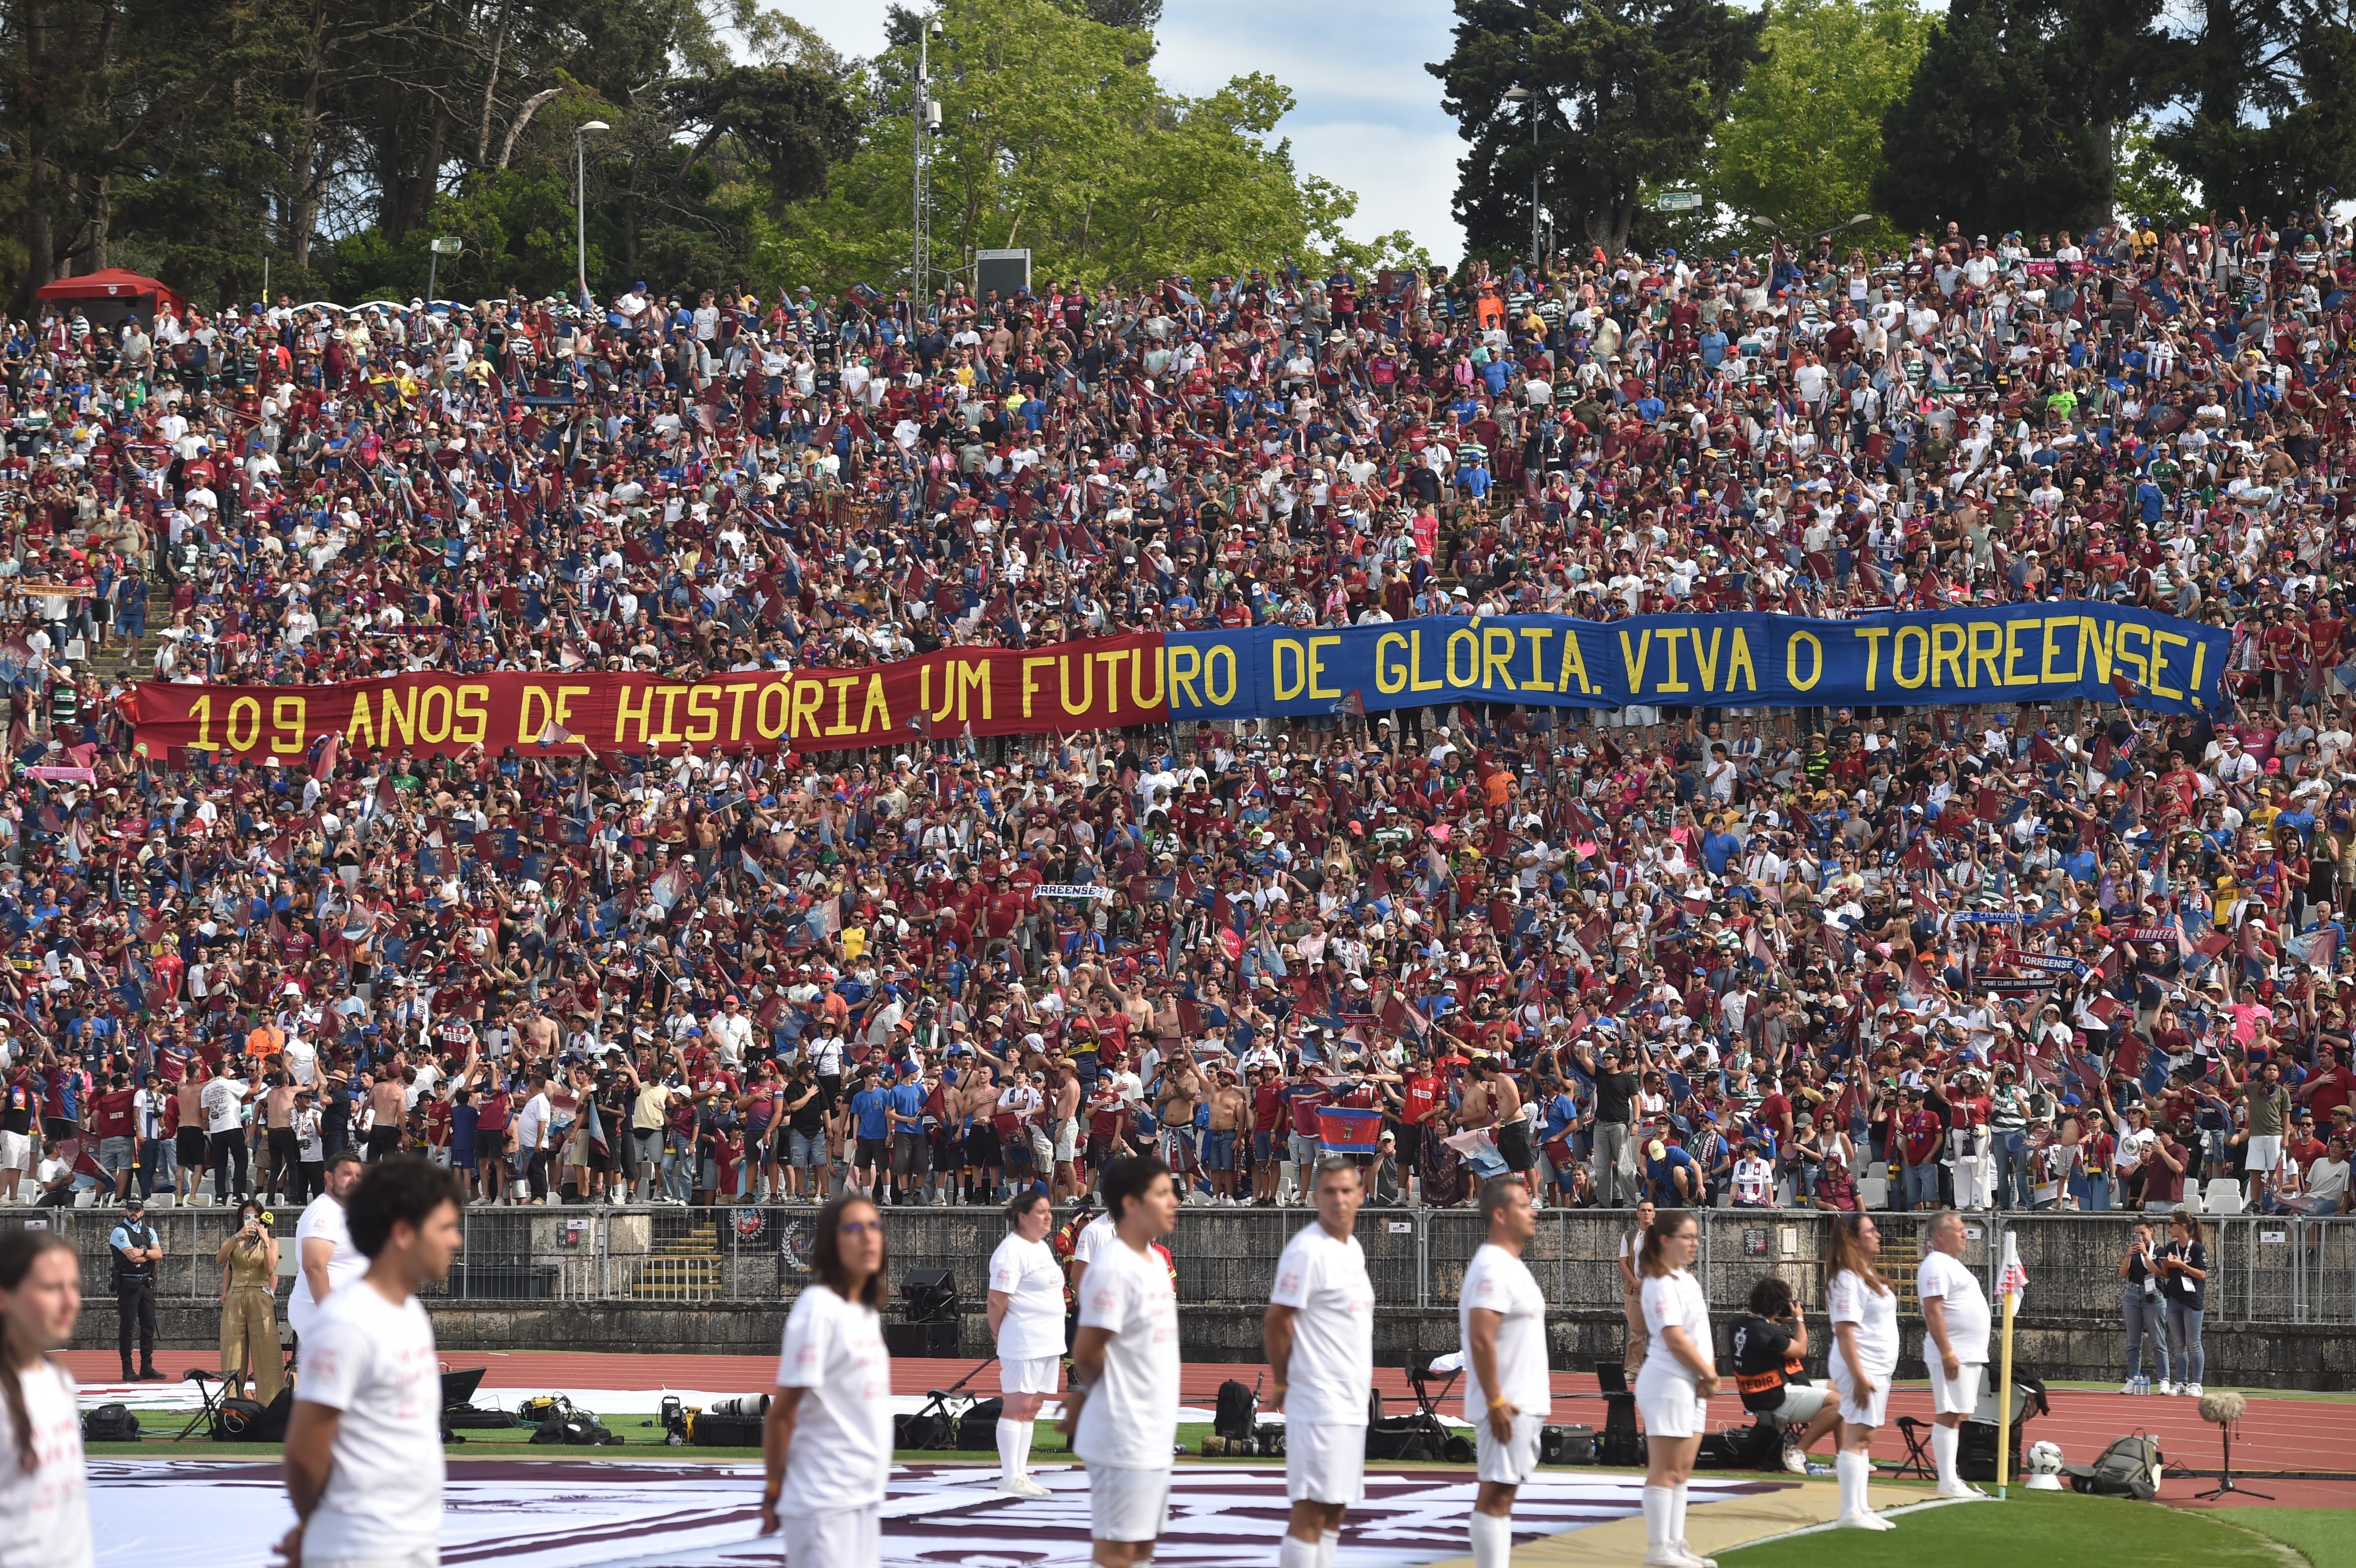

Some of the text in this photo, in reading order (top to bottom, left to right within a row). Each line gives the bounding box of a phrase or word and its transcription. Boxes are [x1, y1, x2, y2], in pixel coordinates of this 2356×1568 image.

[188, 696, 305, 753] 109
[346, 686, 489, 748] ANOS
[518, 686, 589, 743] DE
[616, 671, 891, 742] HISTÓRIA
[921, 659, 991, 721] UM
[1023, 645, 1236, 718] FUTURO
[1274, 636, 1341, 700] DE
[1620, 628, 1756, 693] VIVA
[1788, 631, 1822, 690] O
[1855, 616, 2205, 707] TORREENSE!
[1035, 884, 1096, 895] ORREENSE
[2019, 955, 2074, 969] TORREENSE
